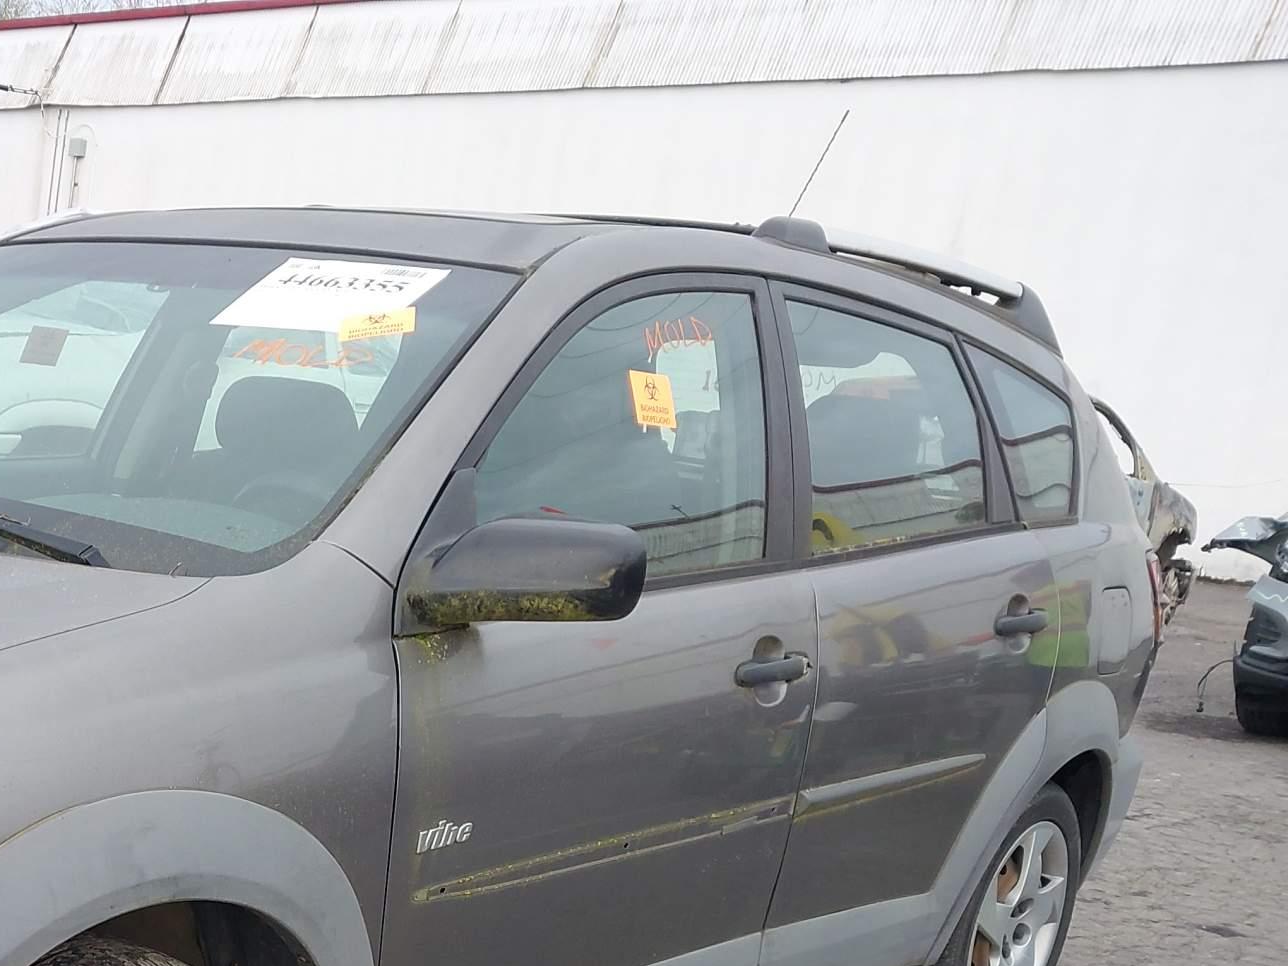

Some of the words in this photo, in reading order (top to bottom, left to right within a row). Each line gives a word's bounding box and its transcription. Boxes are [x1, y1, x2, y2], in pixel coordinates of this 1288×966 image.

[278, 273, 411, 293] 44663355
[643, 316, 713, 356] MOLD
[231, 337, 374, 368] MOLD
